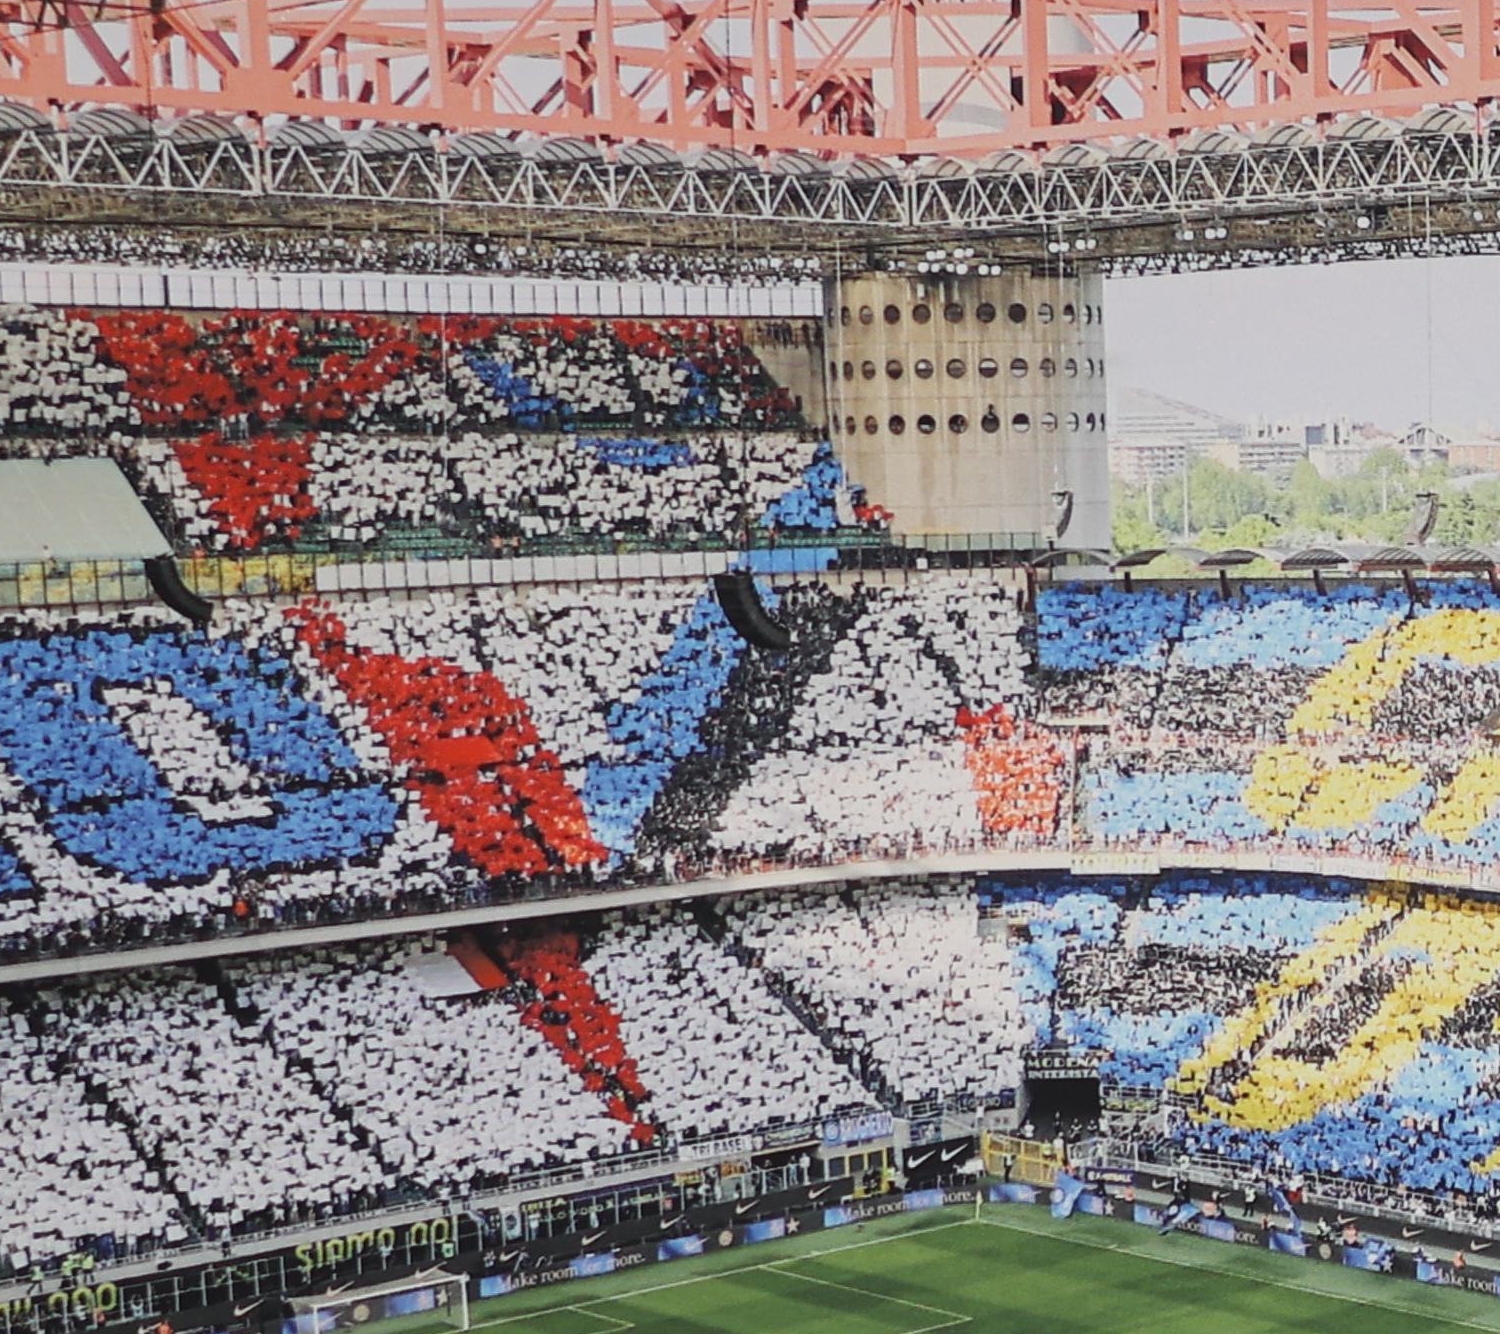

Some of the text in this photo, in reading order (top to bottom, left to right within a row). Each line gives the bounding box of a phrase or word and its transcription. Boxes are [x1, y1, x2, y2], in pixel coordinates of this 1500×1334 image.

[1027, 1057, 1099, 1068] MODENA
[1027, 1069, 1100, 1079] INTERISTA
[876, 1199, 910, 1217] room
[541, 1266, 579, 1284] room
[1467, 1275, 1500, 1293] room
